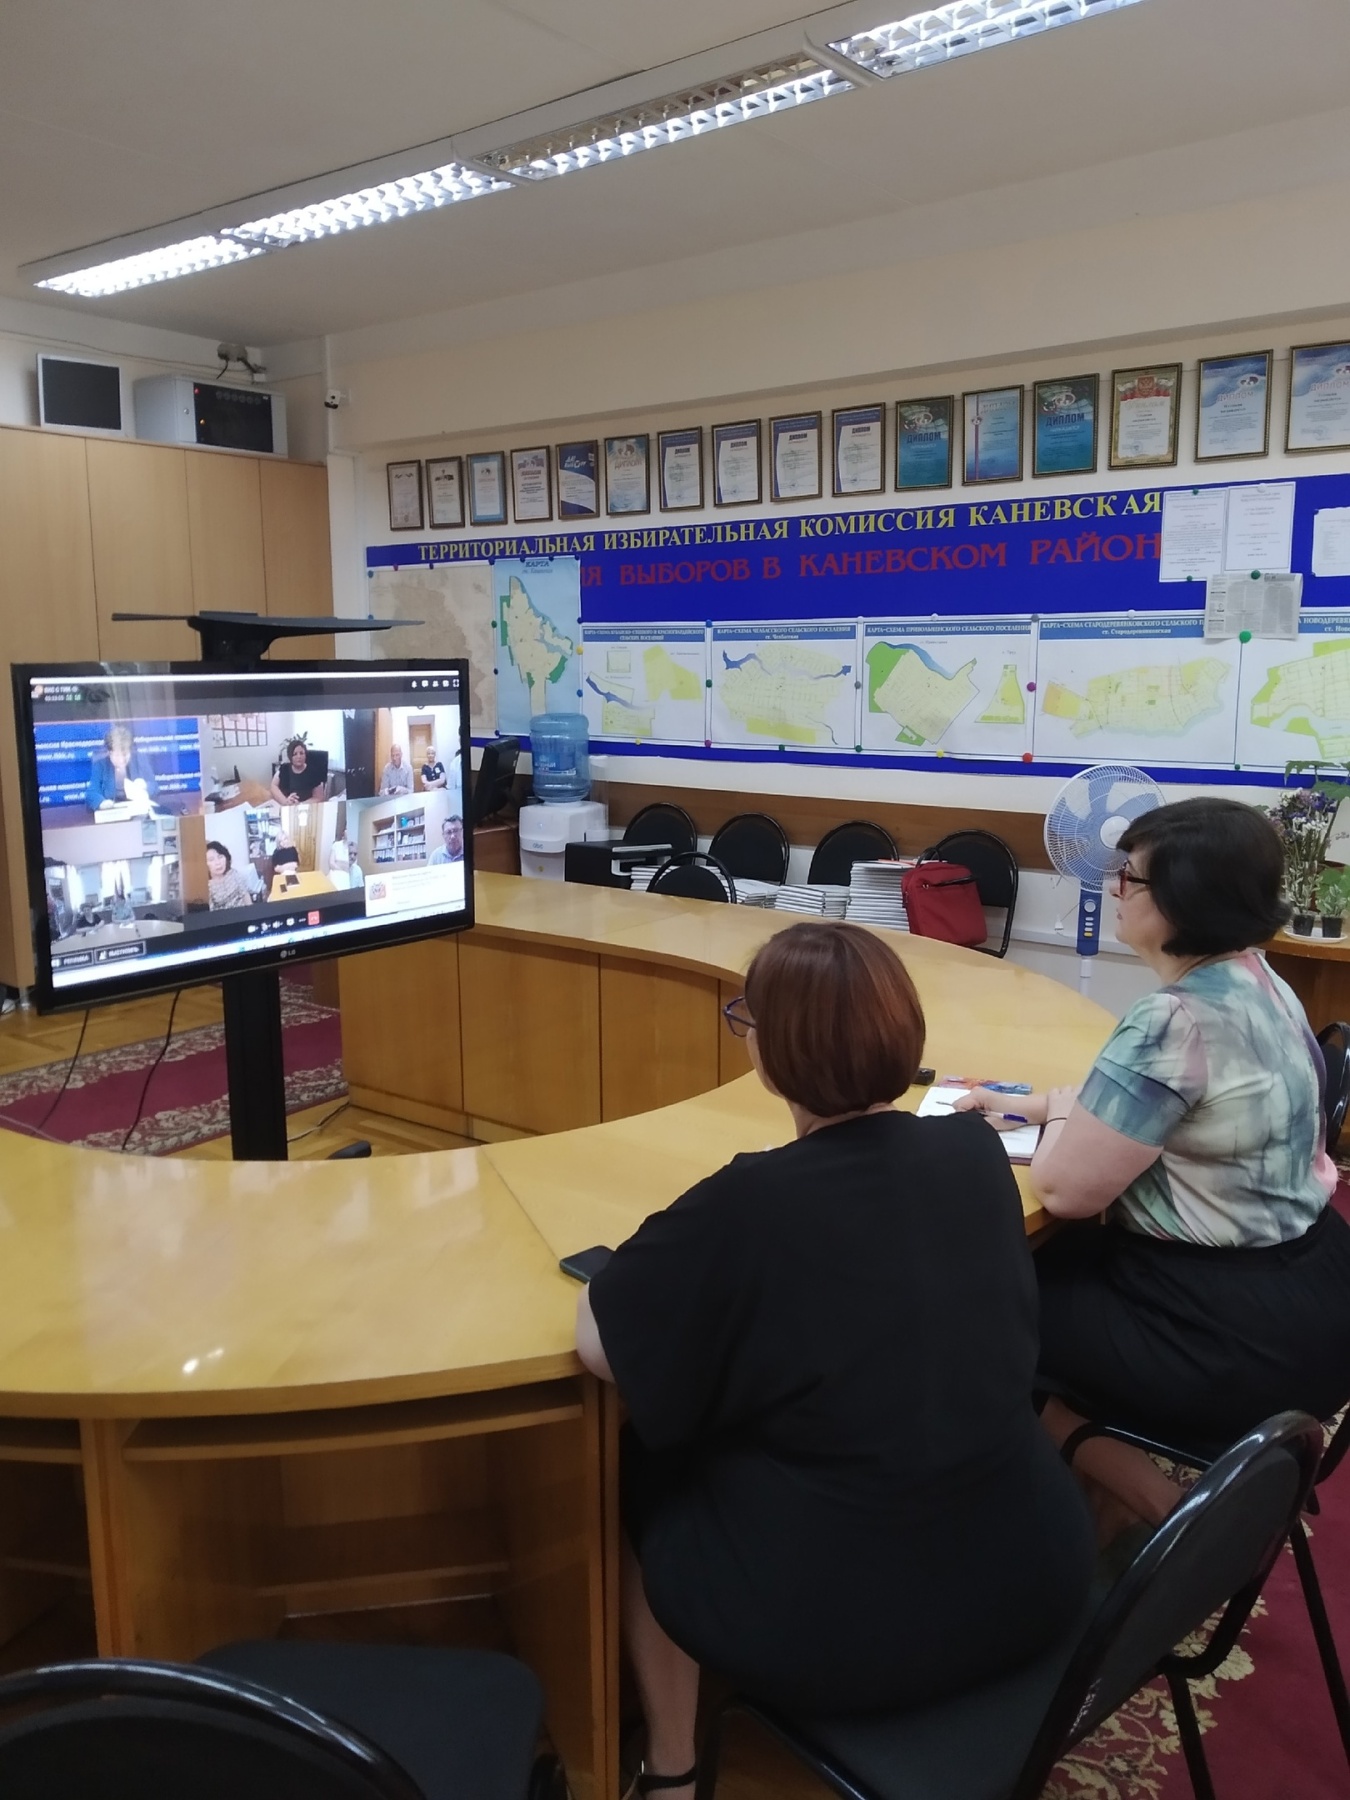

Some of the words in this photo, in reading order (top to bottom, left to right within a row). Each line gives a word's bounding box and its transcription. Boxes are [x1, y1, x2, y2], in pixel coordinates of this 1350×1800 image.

[1046, 413, 1085, 427] ДИПЛОМ
[907, 432, 942, 444] ДИПЛОМ
[418, 534, 596, 561] ТЕРРИТОРИАЛЬНАЯ
[604, 520, 790, 550] ИЗБИРАТЕЛЬНАЯ
[799, 507, 955, 538] КОМИССИЯ
[619, 559, 750, 586] ВЫБОРОВ
[762, 557, 782, 580] В
[799, 543, 1007, 577] КАНЕВСКОМ
[1084, 620, 1161, 628] СТАРОДЕРЕВЯНКОВСКОГО
